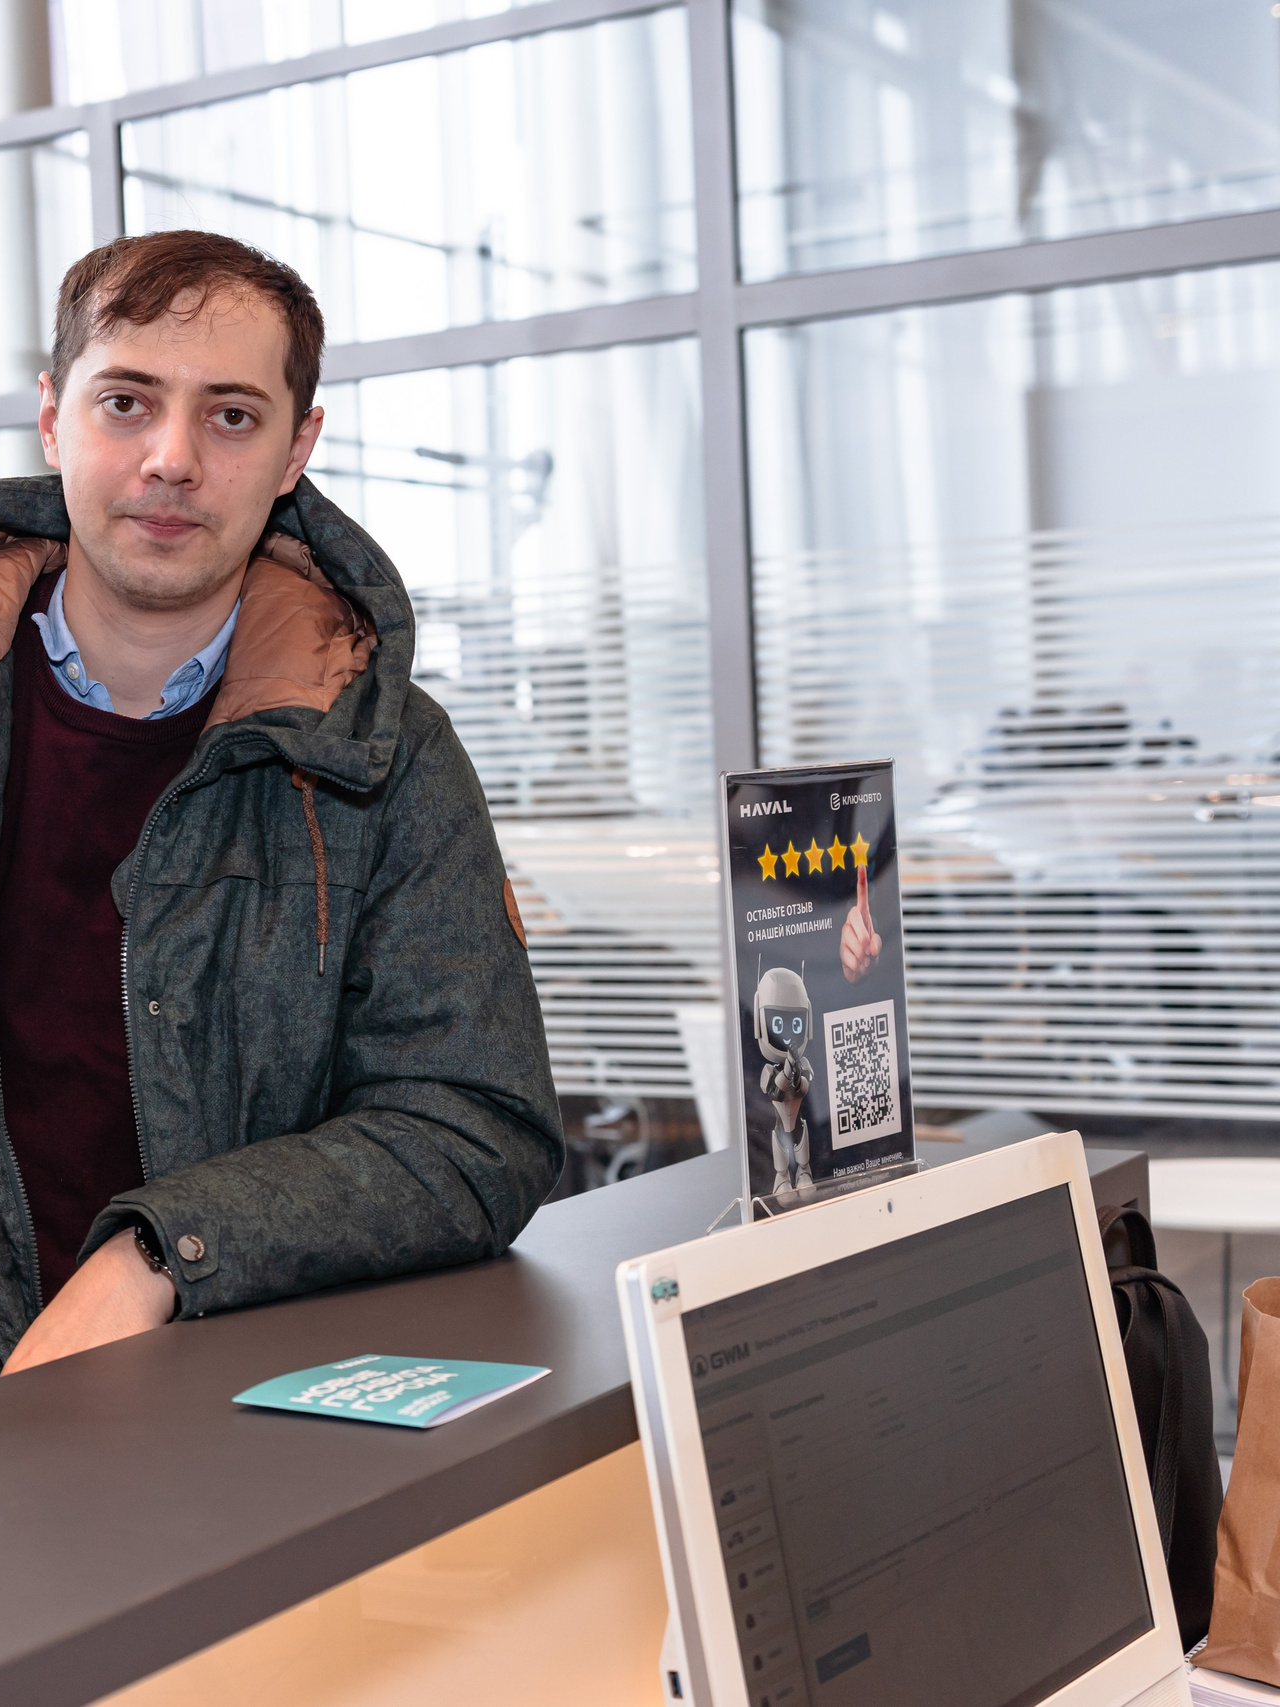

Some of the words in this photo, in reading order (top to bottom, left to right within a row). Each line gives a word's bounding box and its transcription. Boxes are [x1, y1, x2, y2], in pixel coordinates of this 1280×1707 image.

[740, 799, 793, 818] HAVAL
[746, 905, 786, 922] ОСТАВЬТЕ
[787, 901, 814, 917] ОТЗЫВ
[748, 931, 755, 943] О
[755, 923, 785, 941] НАШЕЙ
[785, 917, 833, 937] КОМПАНИИ!
[833, 1167, 847, 1178] Нам
[846, 1162, 866, 1174] важно
[865, 1157, 881, 1169] Ваше
[710, 1341, 750, 1370] GWM
